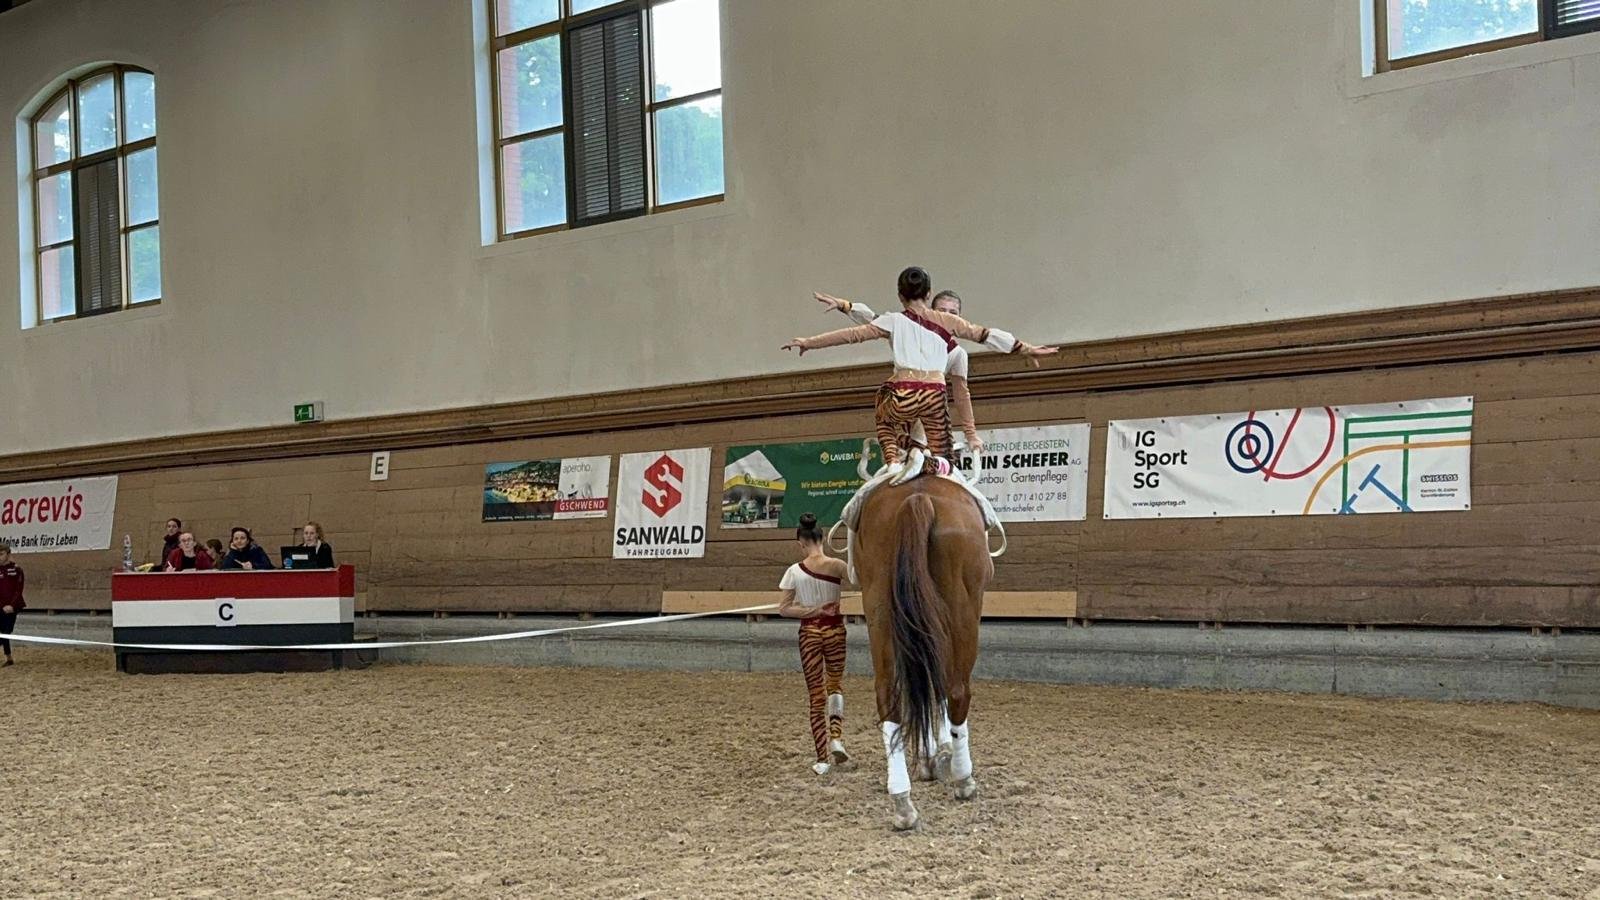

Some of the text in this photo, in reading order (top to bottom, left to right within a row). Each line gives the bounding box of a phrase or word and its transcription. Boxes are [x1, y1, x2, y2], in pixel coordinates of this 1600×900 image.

[1022, 439, 1071, 451] BEGEISTERN
[1135, 430, 1156, 448] IG
[375, 456, 385, 475] E
[830, 453, 854, 461] LAVEBA
[1003, 452, 1069, 469] SCHEFER
[1134, 449, 1188, 471] Sport
[1010, 469, 1068, 485] Gartenpflege
[1133, 471, 1160, 489] SG
[2, 485, 83, 525] acrevis
[560, 500, 605, 511] GSCHWEND
[1014, 494, 1027, 502] 071
[1029, 493, 1044, 501] 410
[1046, 492, 1055, 501] 27
[21, 535, 38, 548] Bank
[40, 534, 54, 547] fürs
[55, 533, 78, 546] Leben
[616, 525, 704, 546] SANWALD
[627, 548, 690, 556] FAHRZEUGBAU
[219, 603, 234, 621] C
